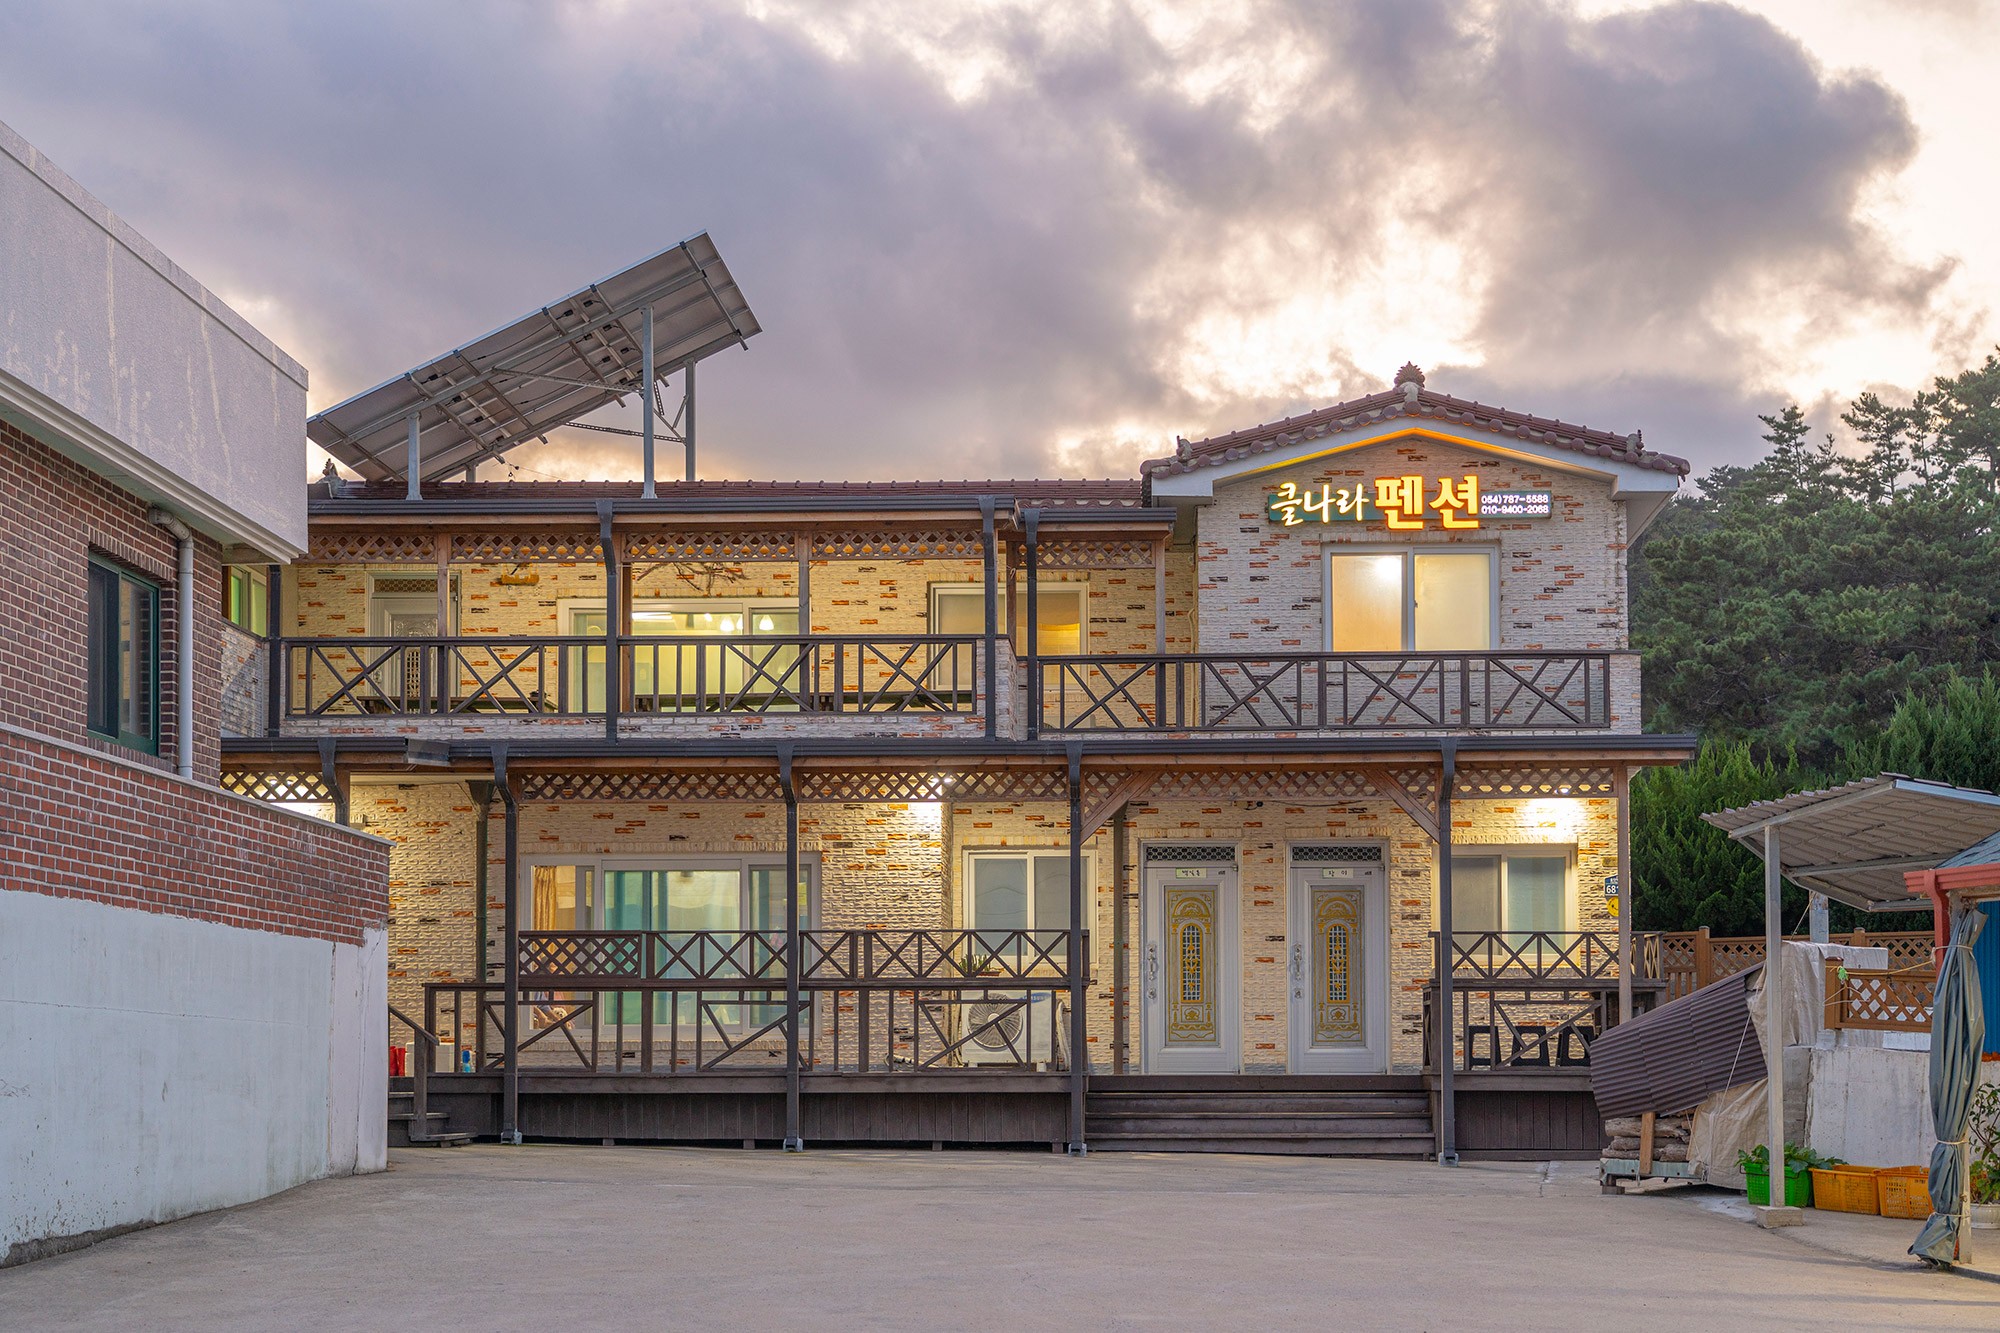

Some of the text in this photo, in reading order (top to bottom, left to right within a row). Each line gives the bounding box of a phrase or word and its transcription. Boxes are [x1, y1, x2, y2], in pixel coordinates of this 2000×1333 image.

[1270, 475, 1479, 530] 클나라 펜션
[1481, 494, 1549, 504] 054)787-5588
[1606, 885, 1618, 894] 68
